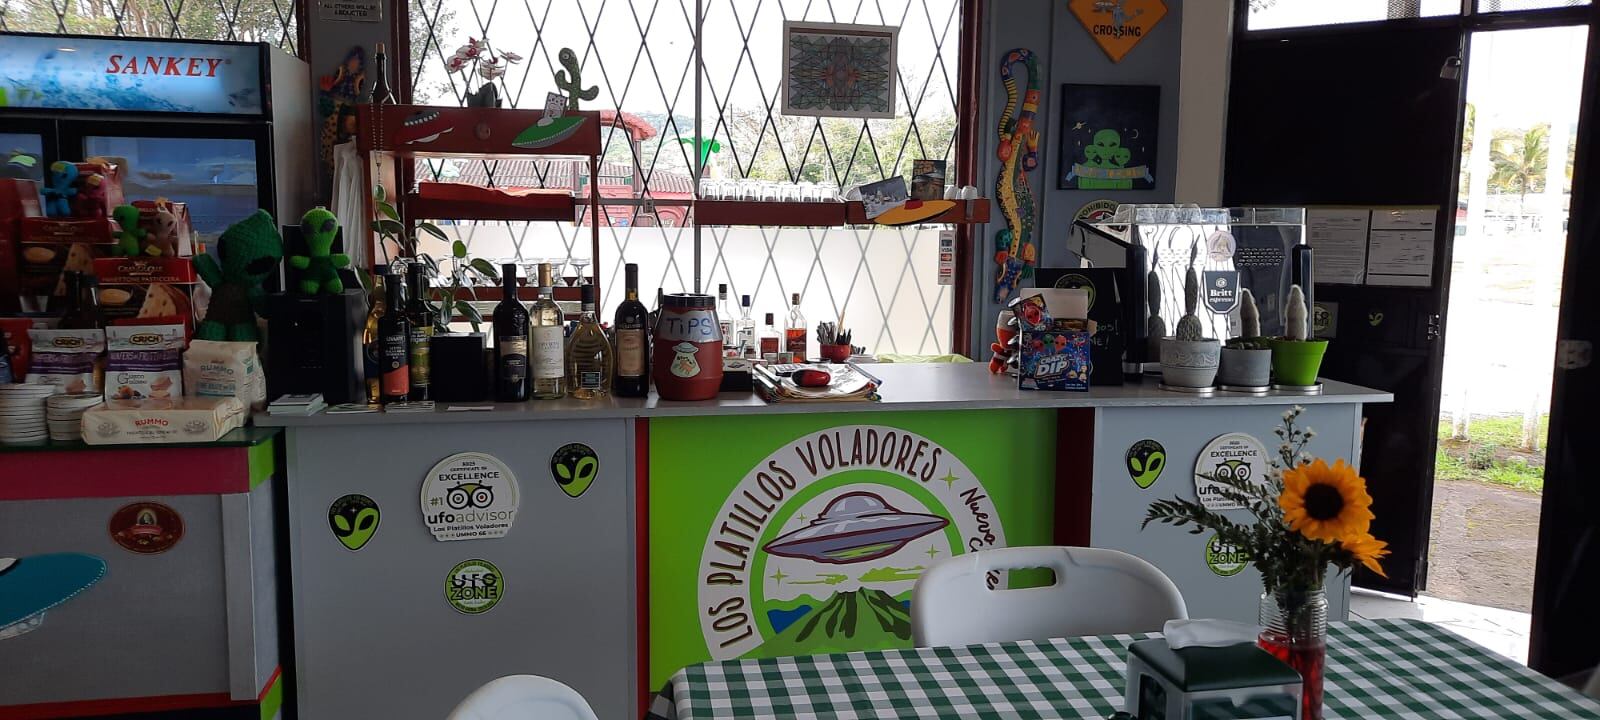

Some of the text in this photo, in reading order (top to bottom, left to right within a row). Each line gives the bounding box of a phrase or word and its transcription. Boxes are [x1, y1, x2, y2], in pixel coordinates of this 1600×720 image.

[1093, 24, 1141, 38] CROSSING
[105, 55, 223, 78] SANKEY
[1210, 288, 1233, 297] Britt
[133, 334, 160, 343] CRICH
[200, 363, 235, 376] RUMMO
[1036, 359, 1069, 377] DIP
[134, 418, 169, 427] RUMMO
[1210, 450, 1258, 458] EXCELLENCE
[439, 471, 500, 482] EXCELLENCE
[430, 497, 444, 507] #1
[428, 509, 514, 524] ufoadvisor
[959, 487, 997, 546] Nuevo
[706, 428, 942, 650] LOS PLATILLOS VOLADORES
[1209, 552, 1246, 565] ZONE
[451, 573, 498, 588] UFO
[450, 586, 498, 601] ZONE
